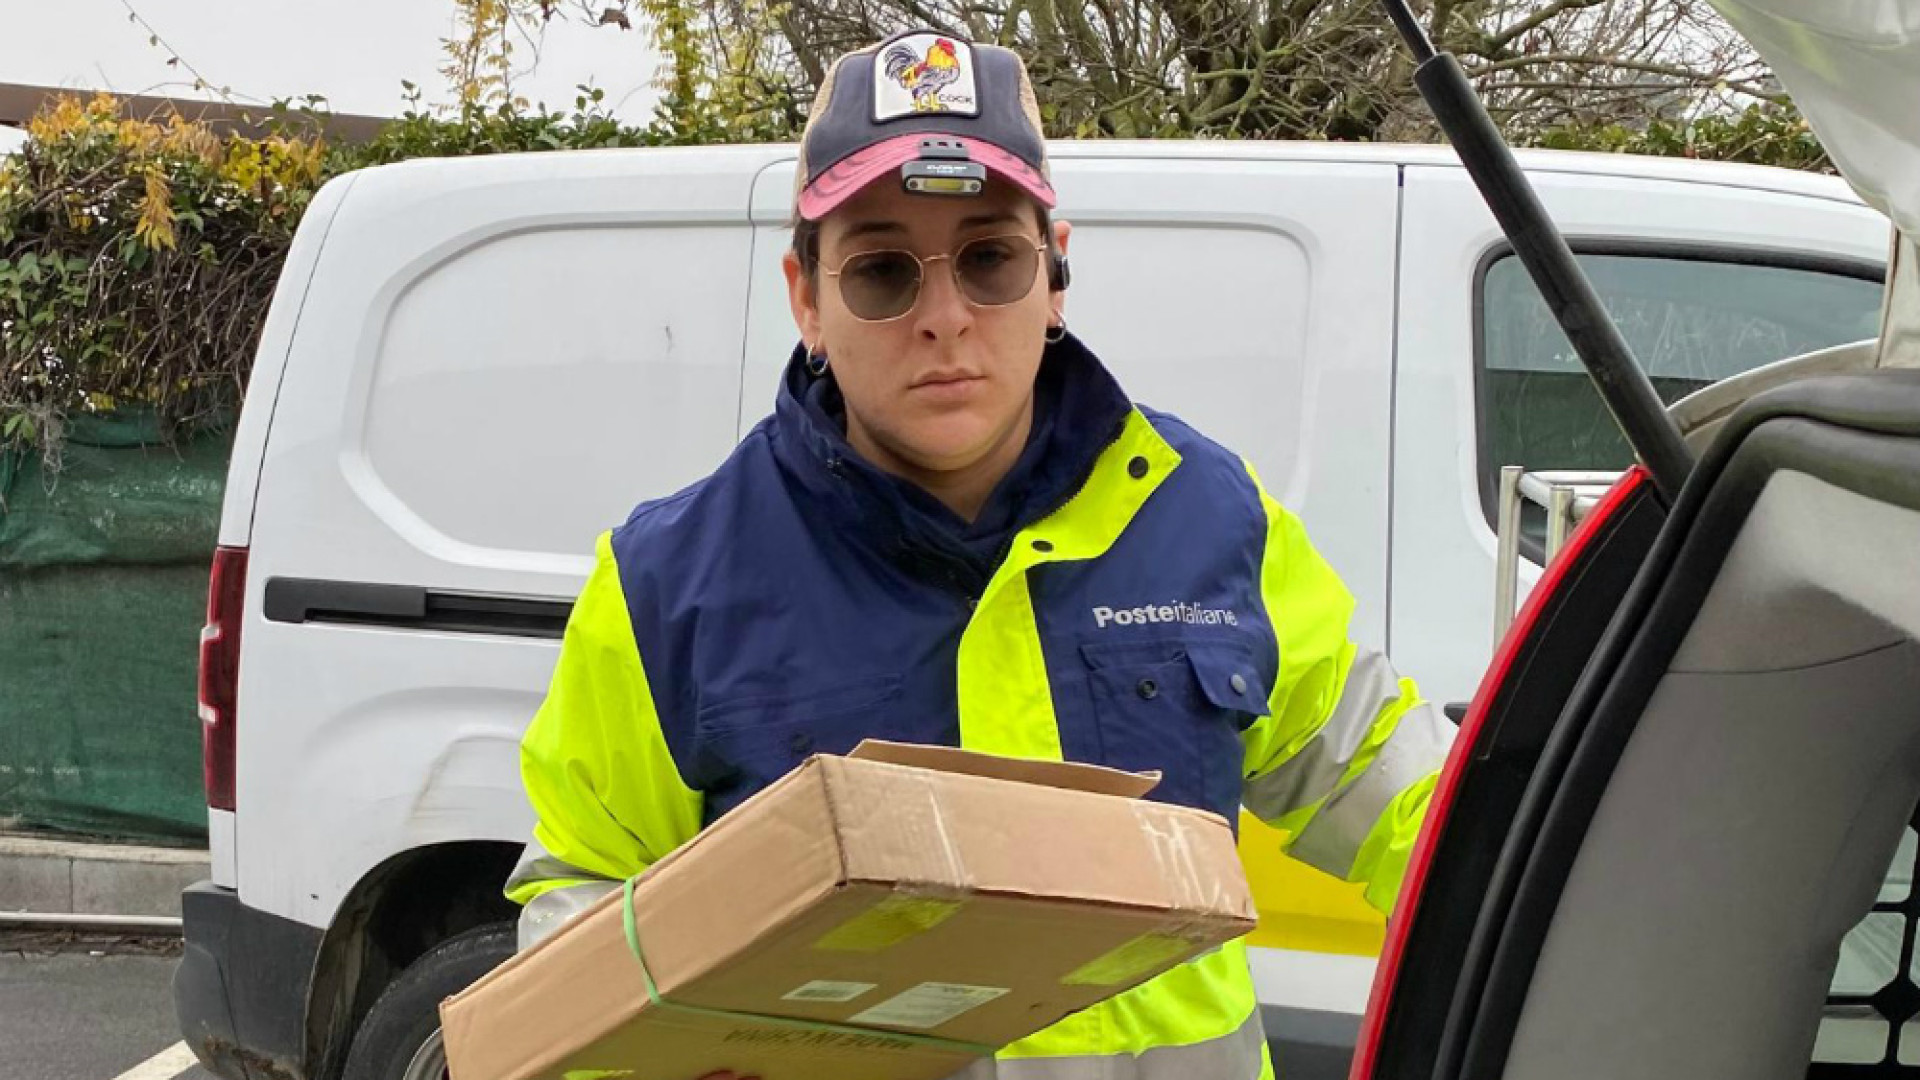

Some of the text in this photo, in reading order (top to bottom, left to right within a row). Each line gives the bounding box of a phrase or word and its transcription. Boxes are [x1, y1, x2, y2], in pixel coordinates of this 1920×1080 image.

[939, 94, 973, 104] COCK
[723, 1030, 812, 1045] CHINA
[838, 1033, 913, 1049] MADE
